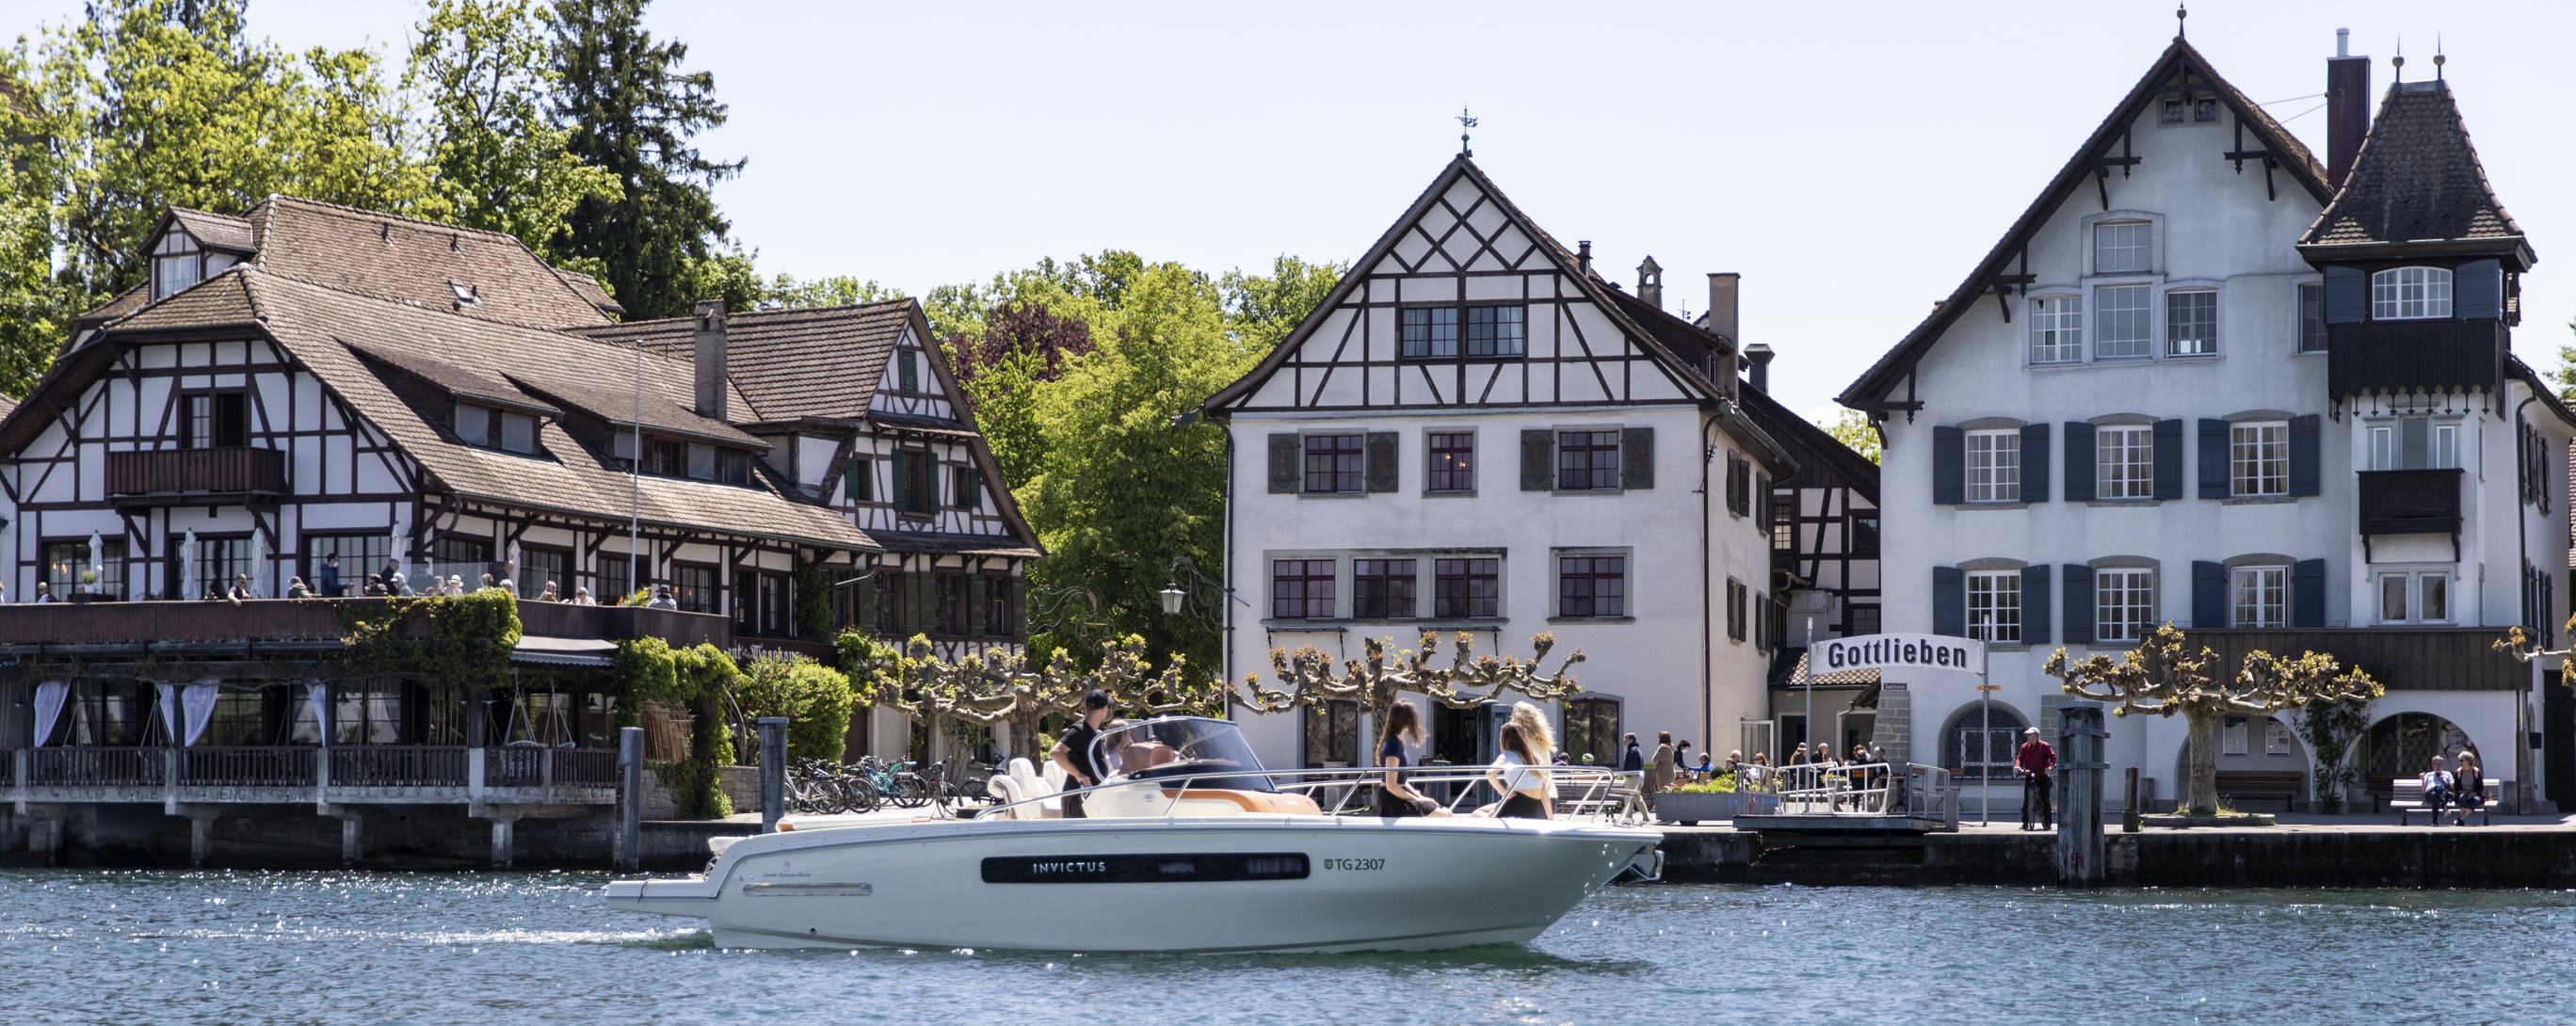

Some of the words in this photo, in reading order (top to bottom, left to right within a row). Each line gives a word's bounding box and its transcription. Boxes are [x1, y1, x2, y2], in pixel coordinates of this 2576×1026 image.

[1828, 638, 1967, 668] Gottlieben
[1033, 861, 1106, 874] INVICTUS
[1334, 858, 1353, 871] TG
[1354, 858, 1385, 871] 2307
